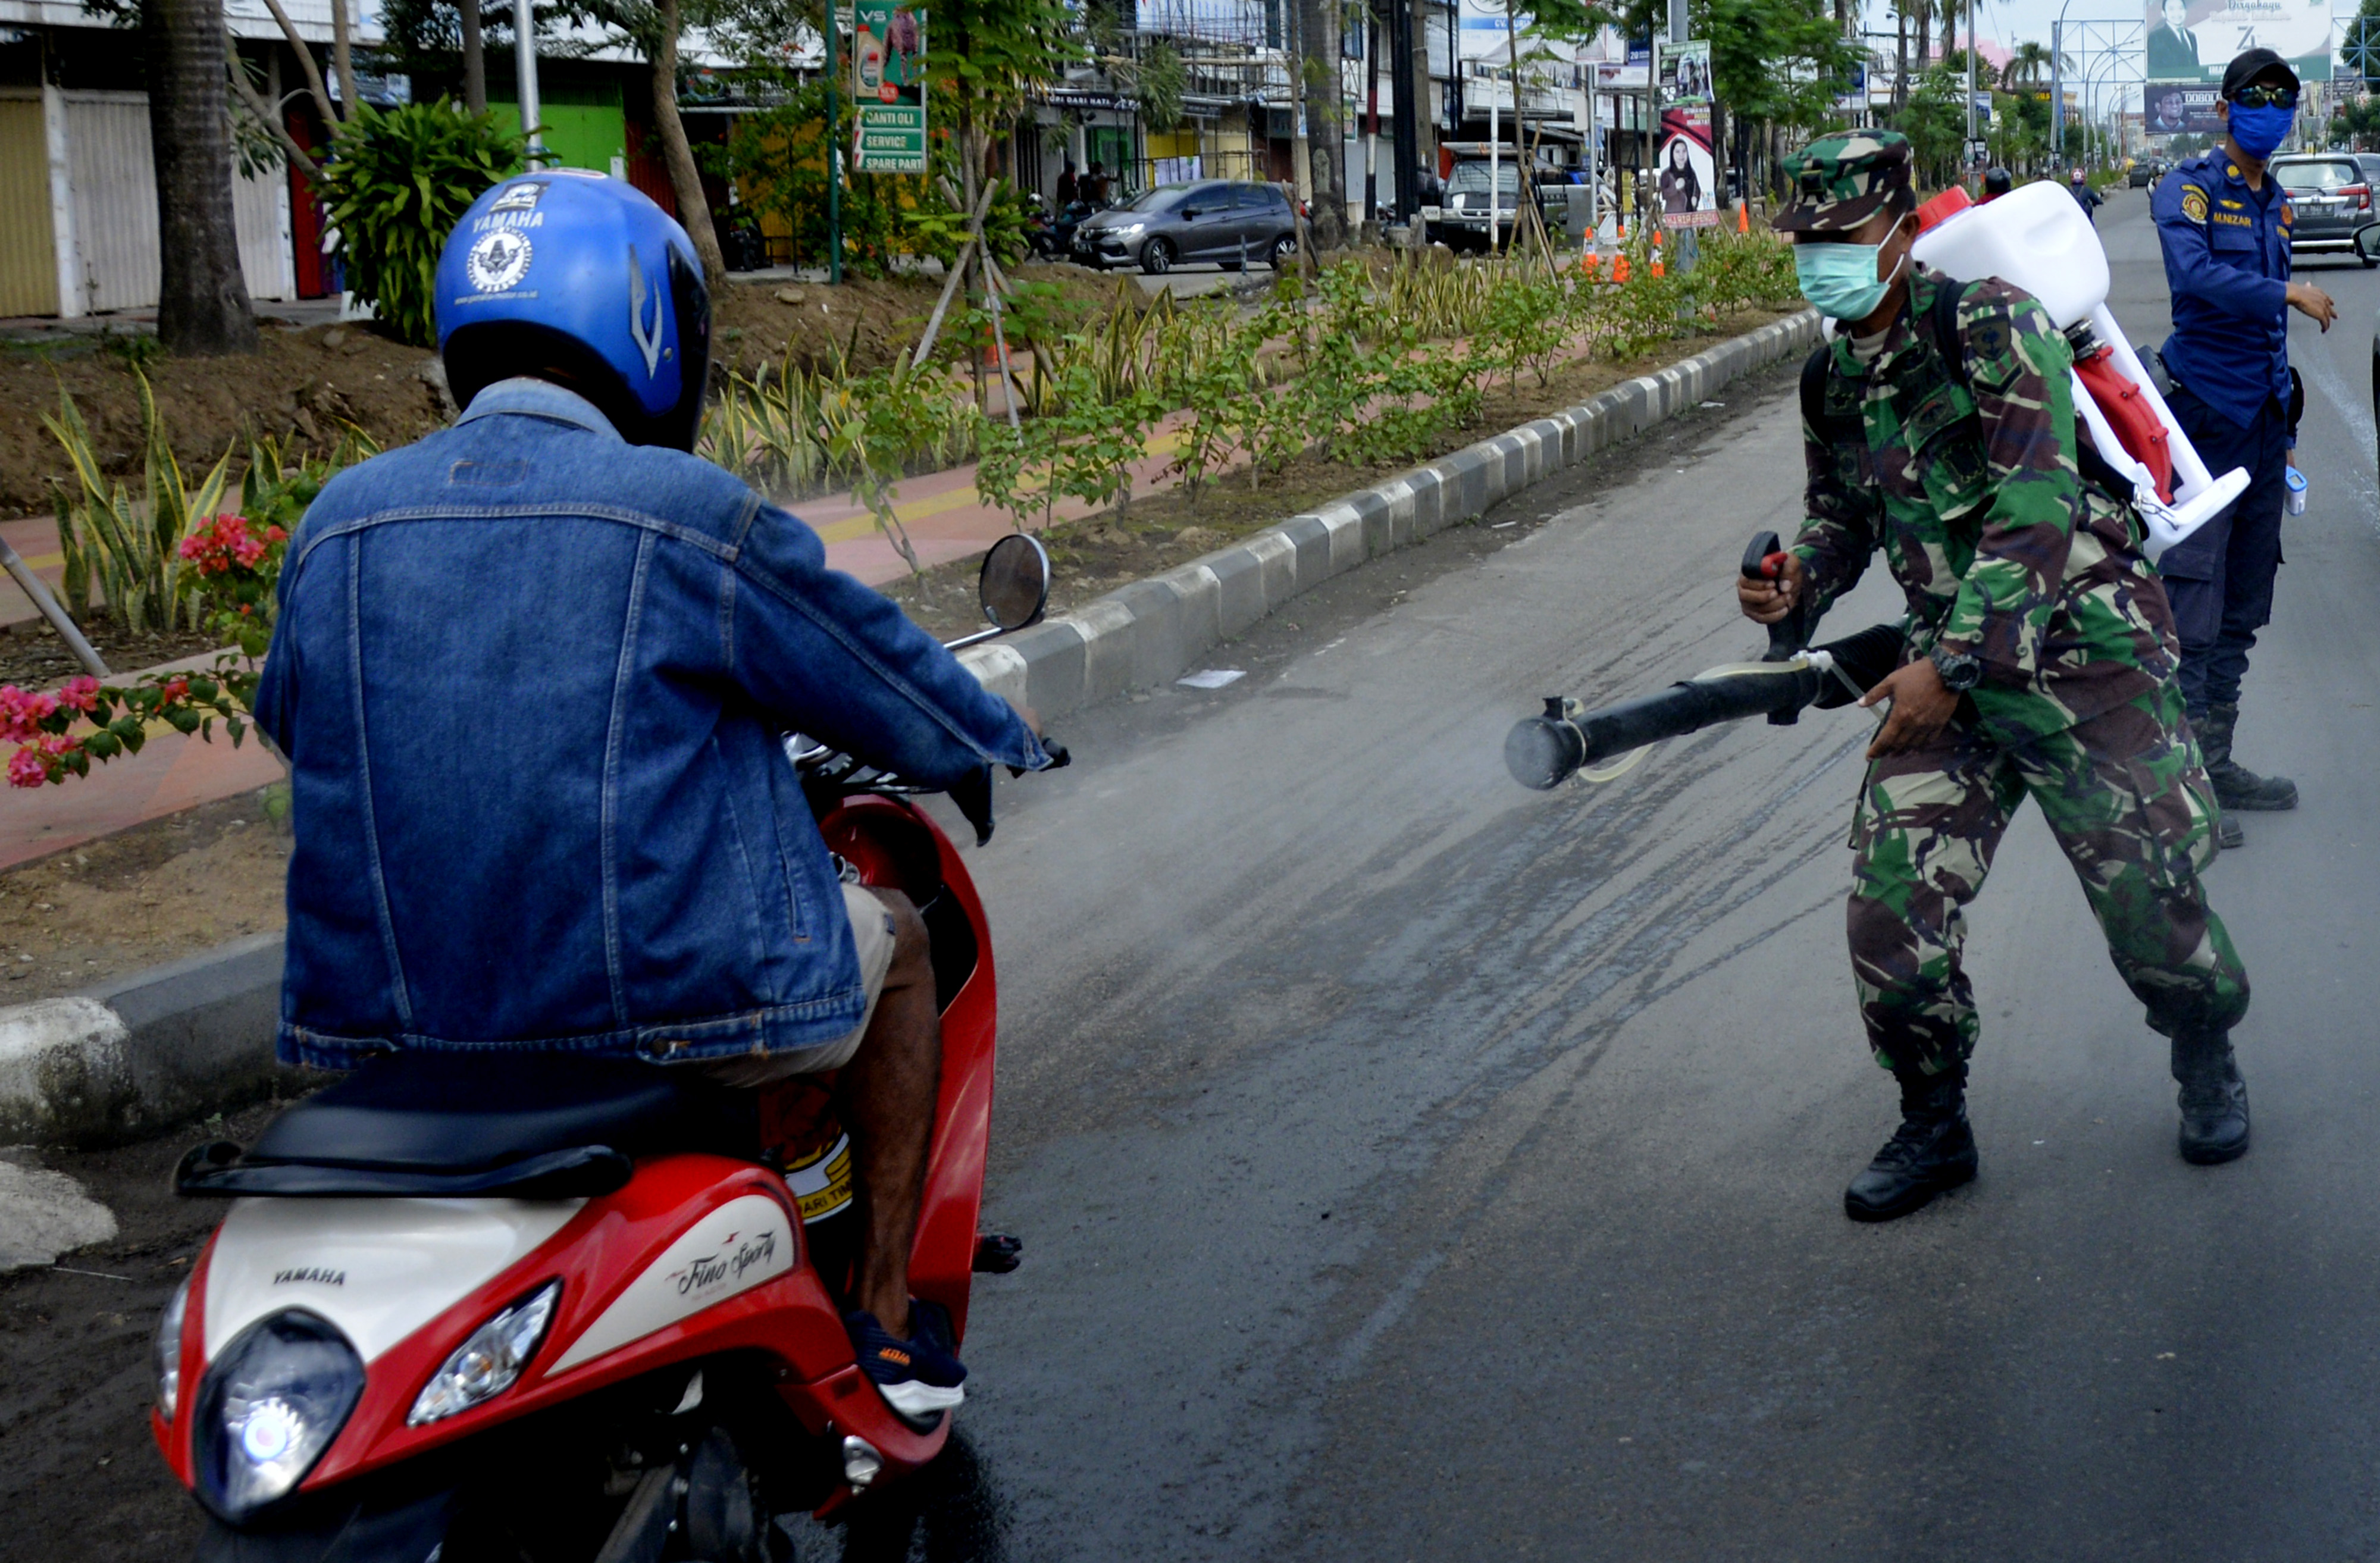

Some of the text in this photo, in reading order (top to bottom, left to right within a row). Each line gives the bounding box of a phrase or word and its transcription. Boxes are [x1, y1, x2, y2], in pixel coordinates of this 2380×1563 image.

[859, 10, 887, 21] VS
[866, 111, 914, 125] GANTI OLI
[866, 134, 906, 148] SERVICE
[866, 157, 922, 170] SPARE PART
[473, 211, 543, 233] YAMAHA
[2213, 211, 2251, 228] M.NIZAR
[679, 1252, 728, 1294] Fino
[731, 1229, 776, 1279] Sporty
[273, 1267, 346, 1286] YAMAHA
